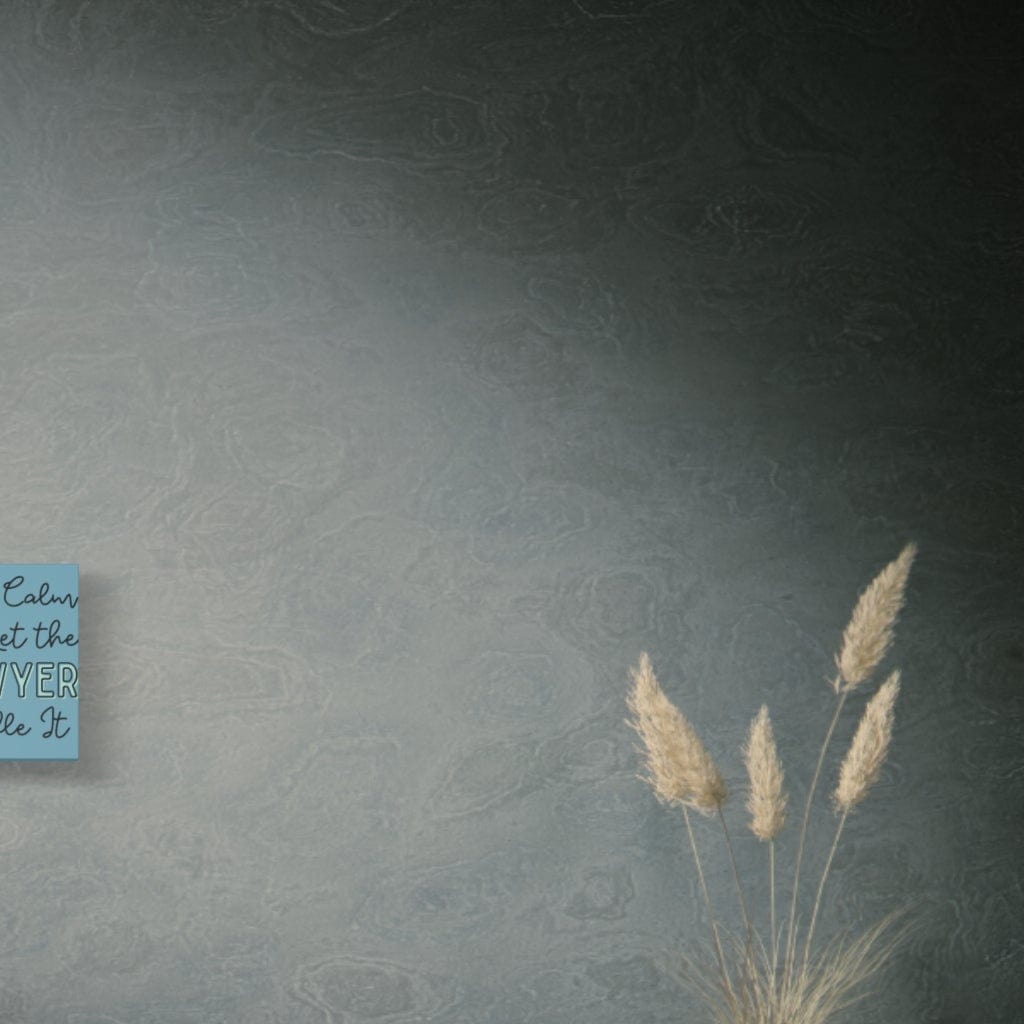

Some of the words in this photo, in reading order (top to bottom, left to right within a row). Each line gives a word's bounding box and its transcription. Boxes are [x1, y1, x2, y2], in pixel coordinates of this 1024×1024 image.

[3, 575, 78, 609] Calm
[33, 619, 78, 649] the
[40, 705, 71, 739] It
